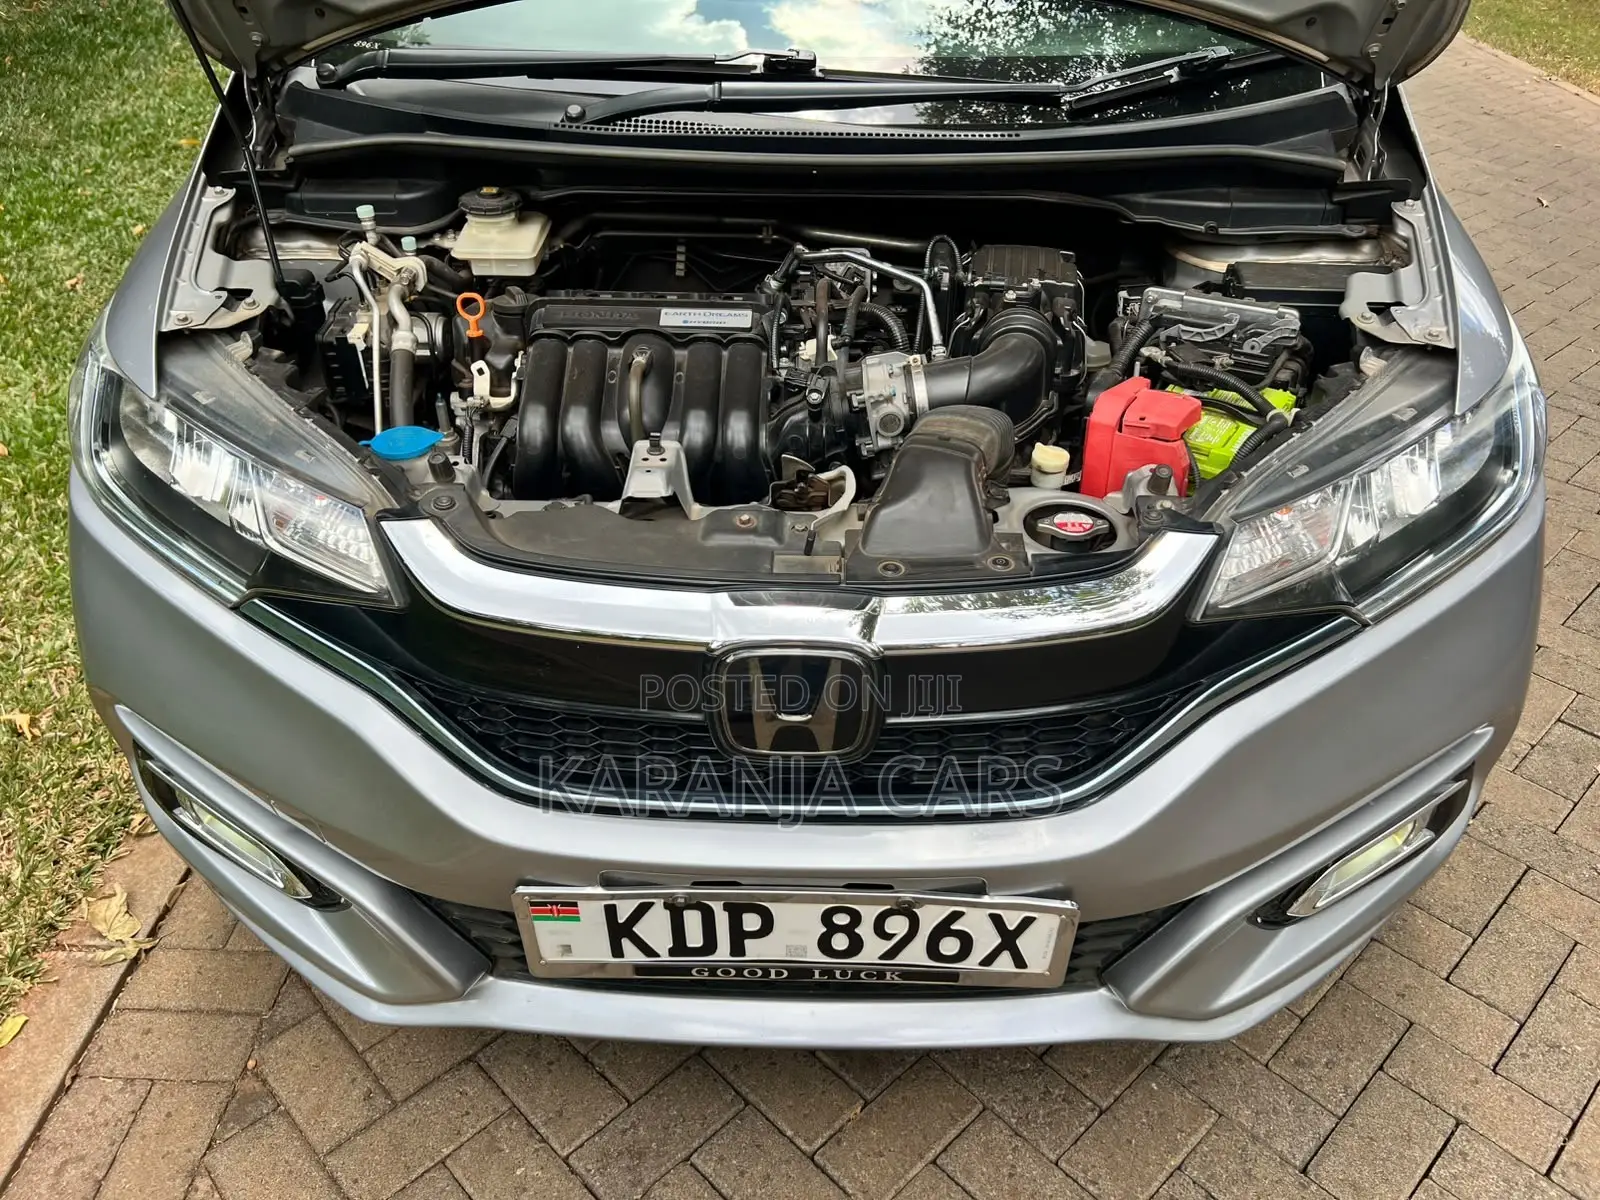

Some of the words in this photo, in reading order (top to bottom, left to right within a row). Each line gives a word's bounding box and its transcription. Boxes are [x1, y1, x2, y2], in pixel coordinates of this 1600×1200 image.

[353, 40, 381, 50] 896X
[603, 901, 775, 958] KDP
[817, 905, 1037, 969] 896X
[690, 966, 789, 980] GOOD
[812, 968, 903, 981] LUCK
